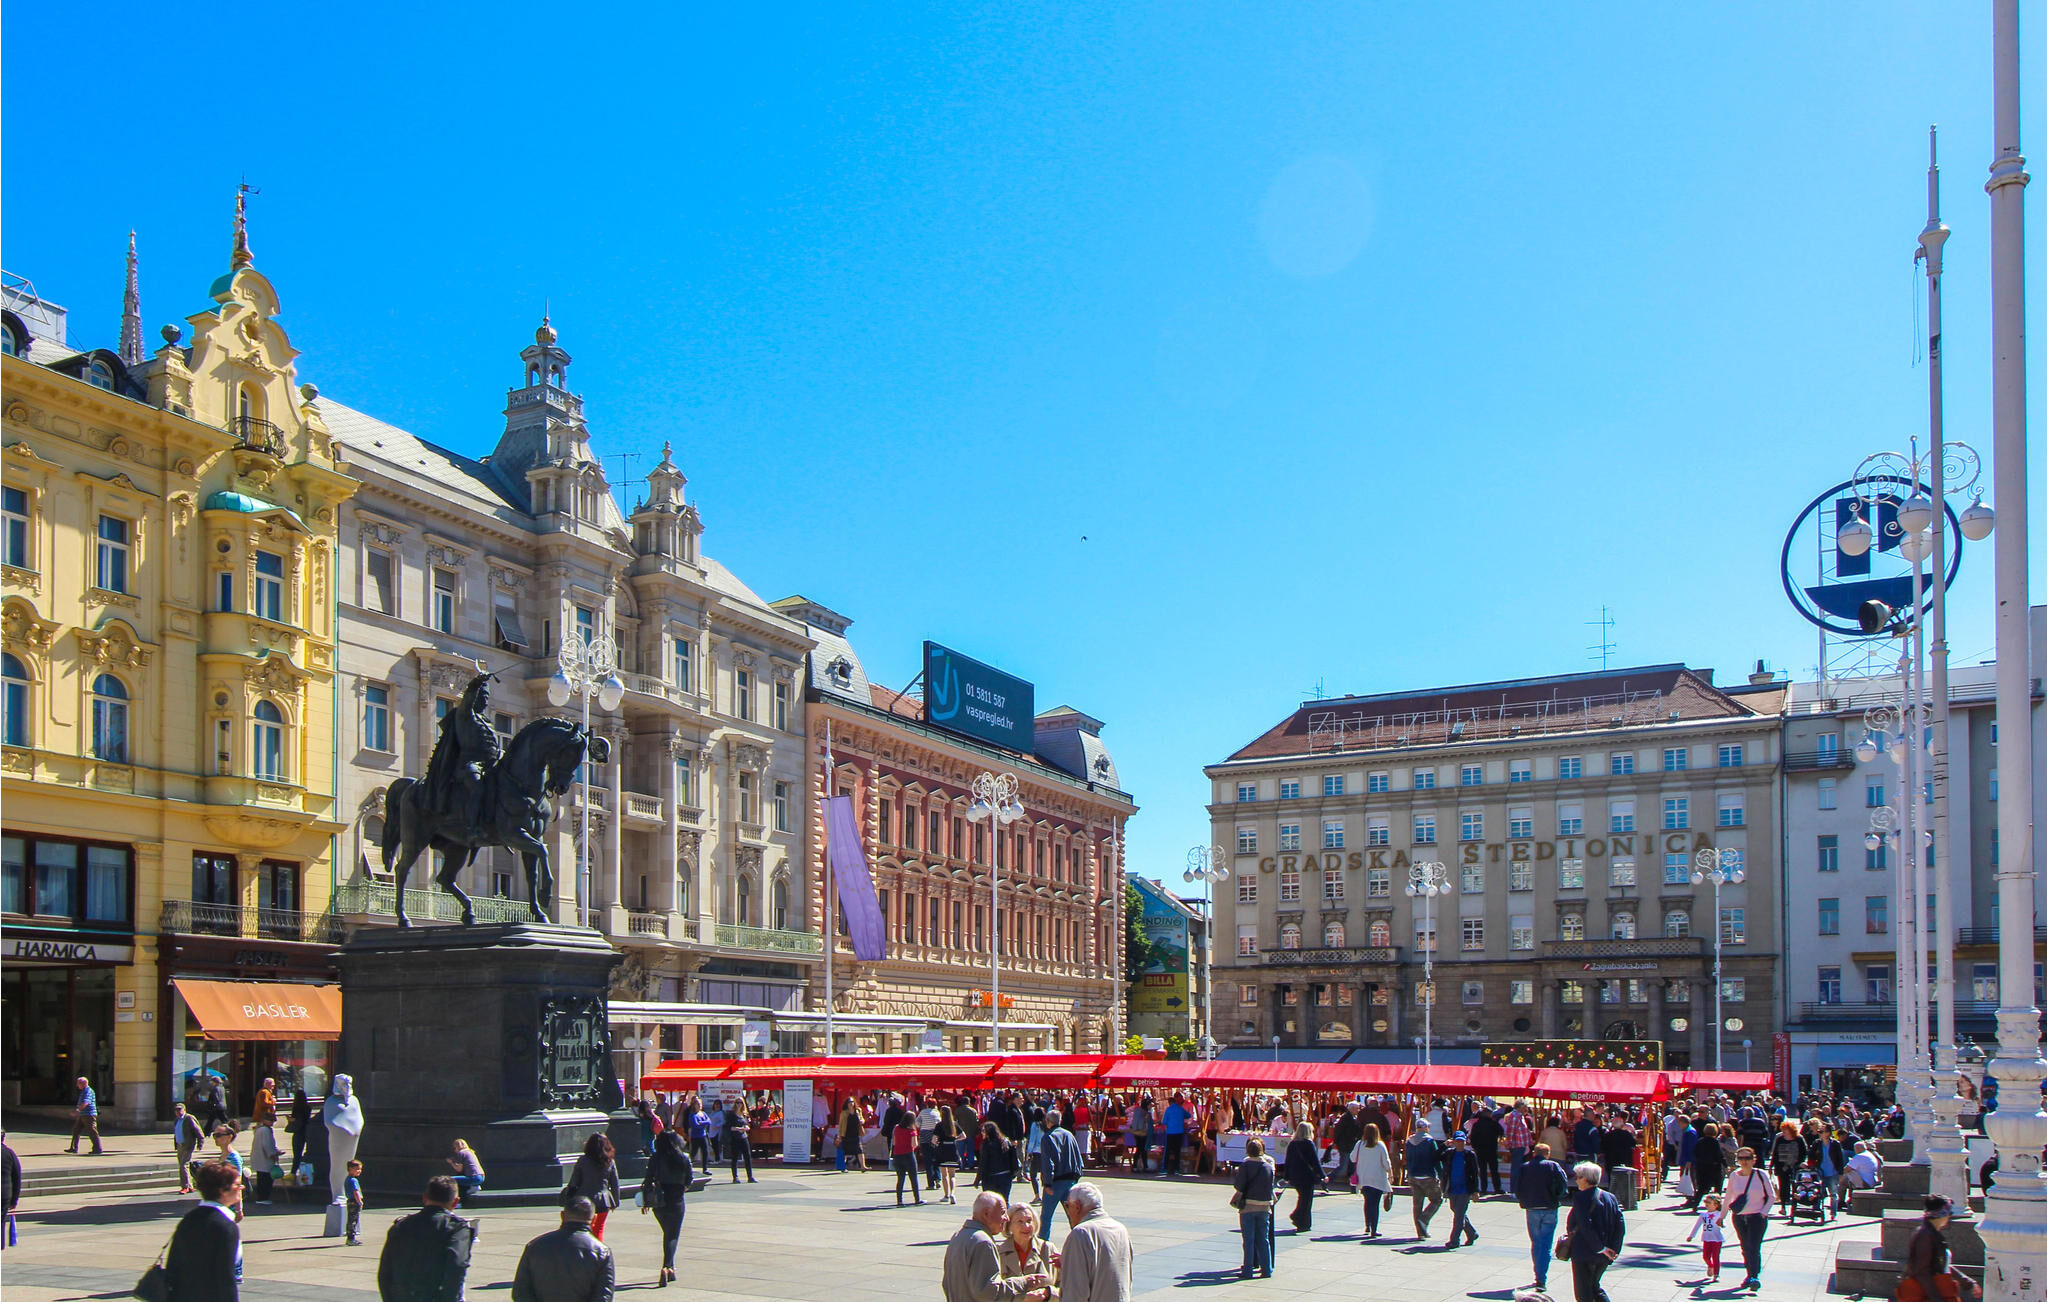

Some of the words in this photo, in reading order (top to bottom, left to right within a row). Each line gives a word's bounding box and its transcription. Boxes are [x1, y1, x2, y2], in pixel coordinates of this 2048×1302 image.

[966, 683, 975, 697] 01
[976, 687, 992, 704] 5811
[993, 694, 1005, 708] 587
[966, 705, 1014, 730] vaspregled.hr
[1259, 850, 1410, 873] GRADSKA
[1463, 832, 1715, 864] ŠTEDIONICA
[16, 941, 97, 960] HARMICA
[1146, 976, 1172, 985] BILLA
[981, 991, 1015, 1008] Mller
[242, 1003, 310, 1018] BASLER
[1577, 1093, 1605, 1101] petrinja
